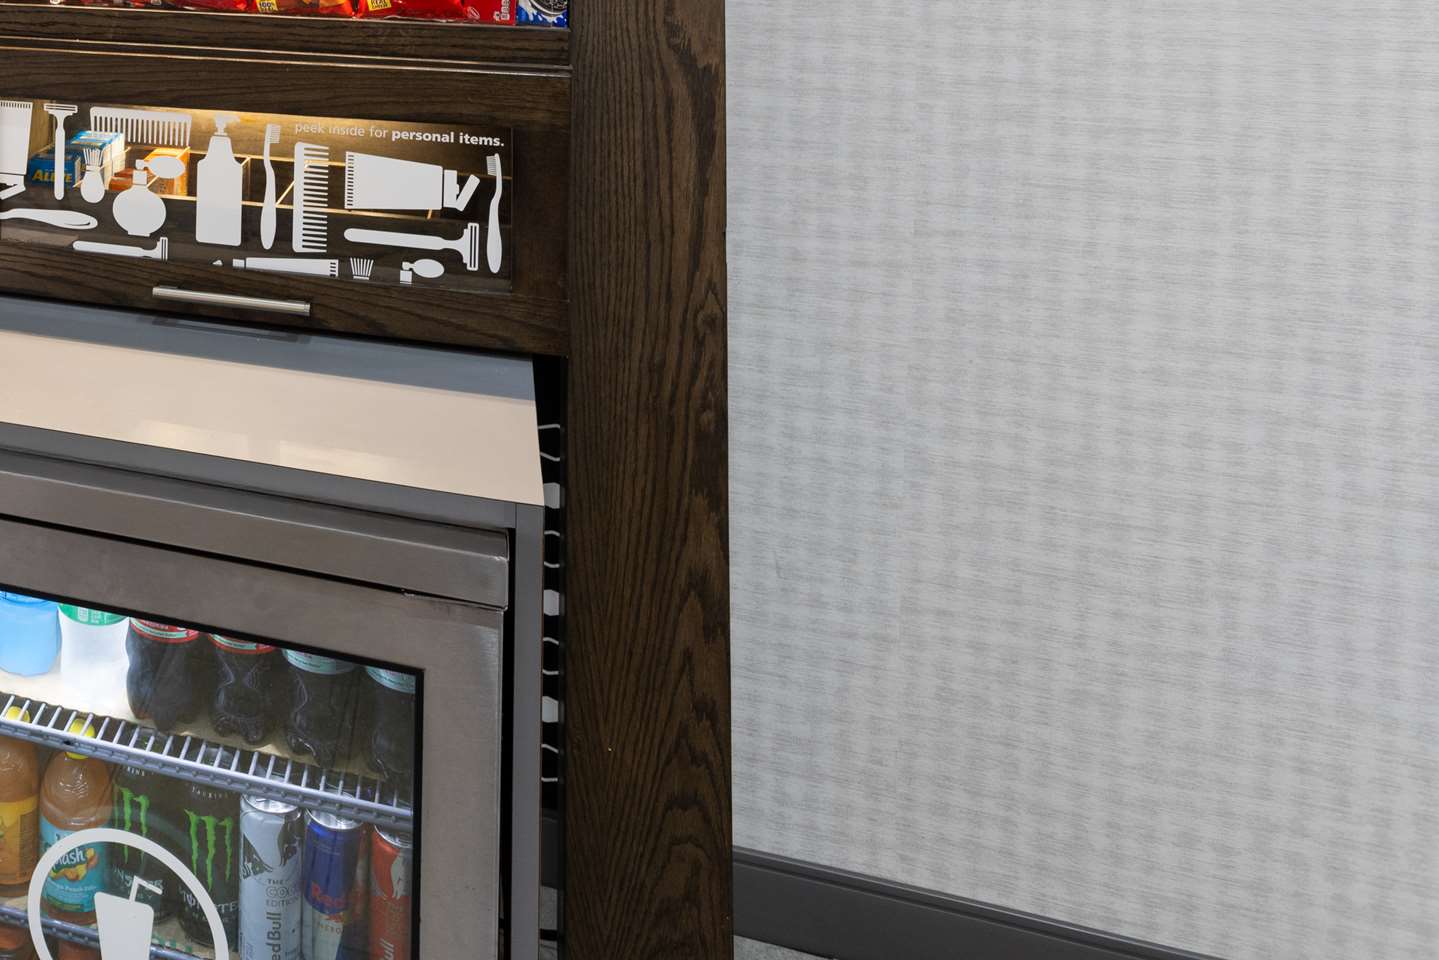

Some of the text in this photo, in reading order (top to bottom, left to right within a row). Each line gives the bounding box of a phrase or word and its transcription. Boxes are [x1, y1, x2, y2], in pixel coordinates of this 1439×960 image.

[295, 122, 505, 148] peek inside for personal items.
